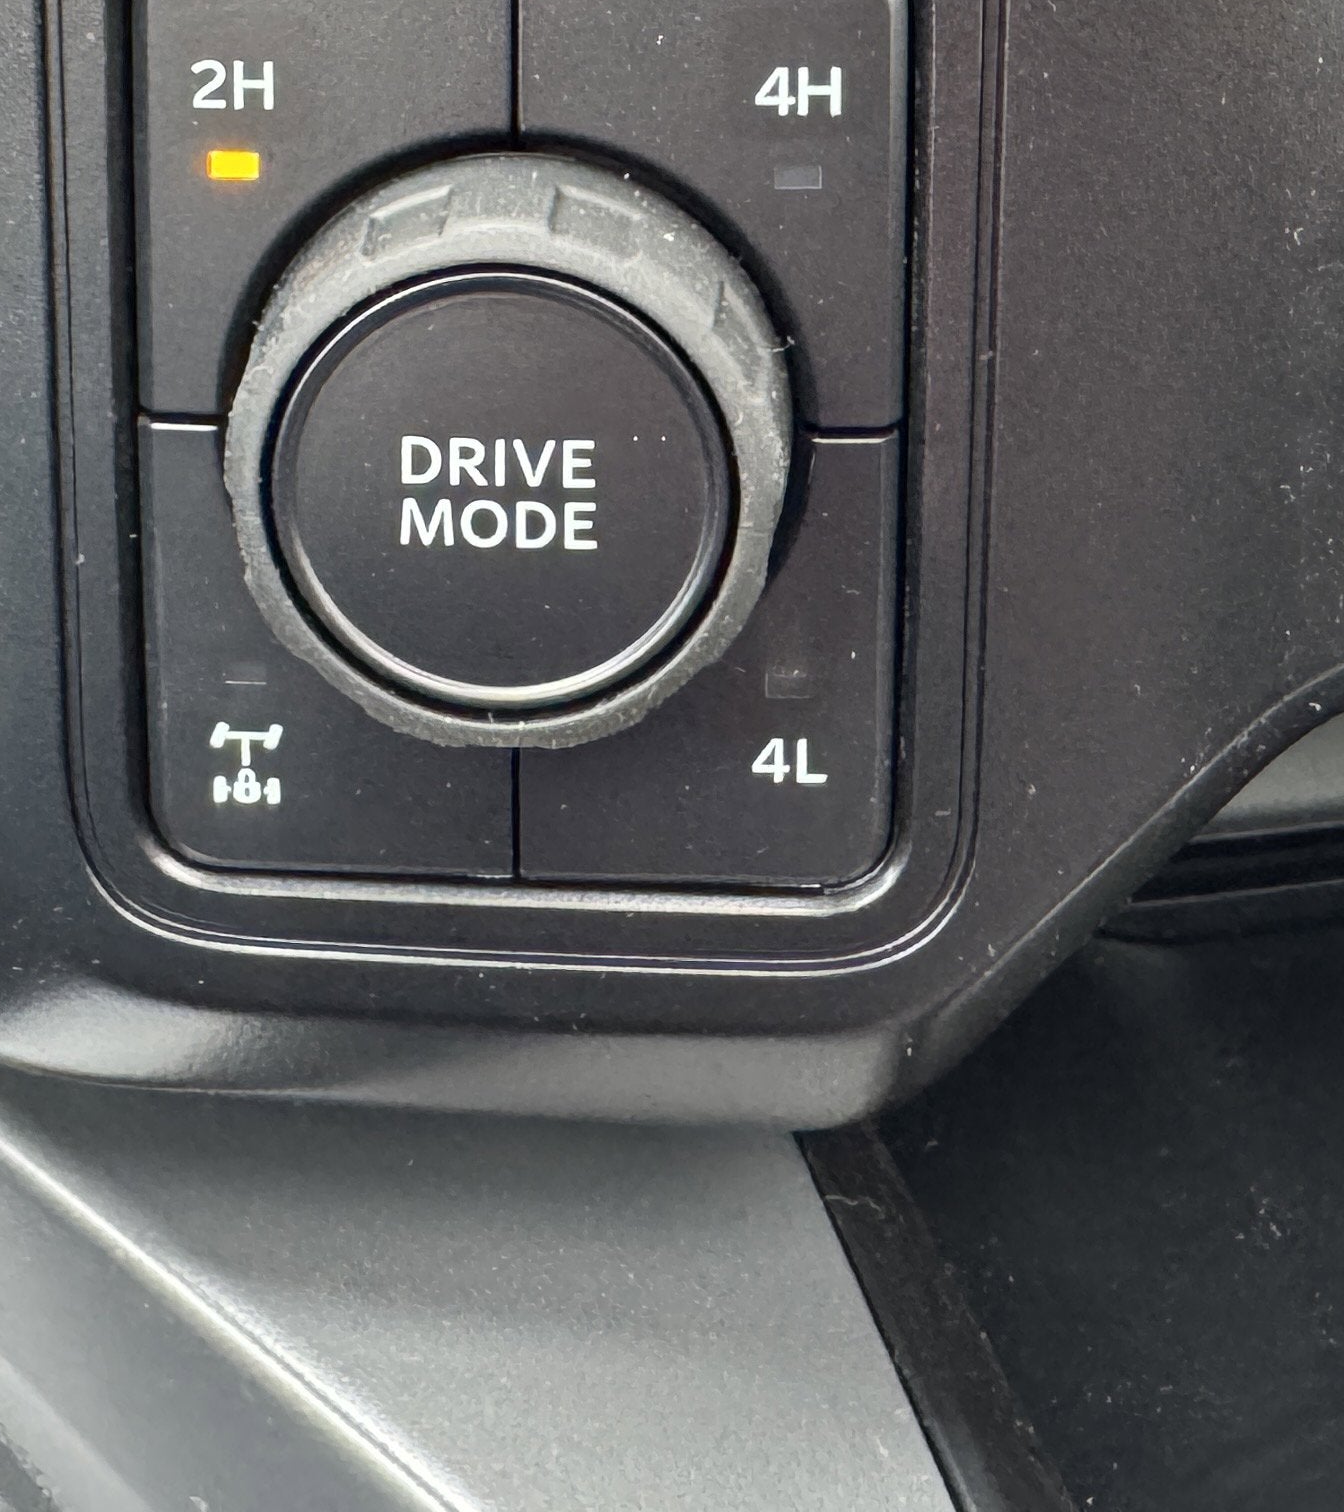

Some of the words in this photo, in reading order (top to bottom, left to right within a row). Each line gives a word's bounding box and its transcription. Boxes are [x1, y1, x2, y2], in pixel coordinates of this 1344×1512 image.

[189, 59, 276, 111] 2H
[754, 65, 844, 118] 4H
[400, 435, 597, 489] DRIVE
[399, 496, 598, 551] MODE
[750, 737, 829, 787] 4L
